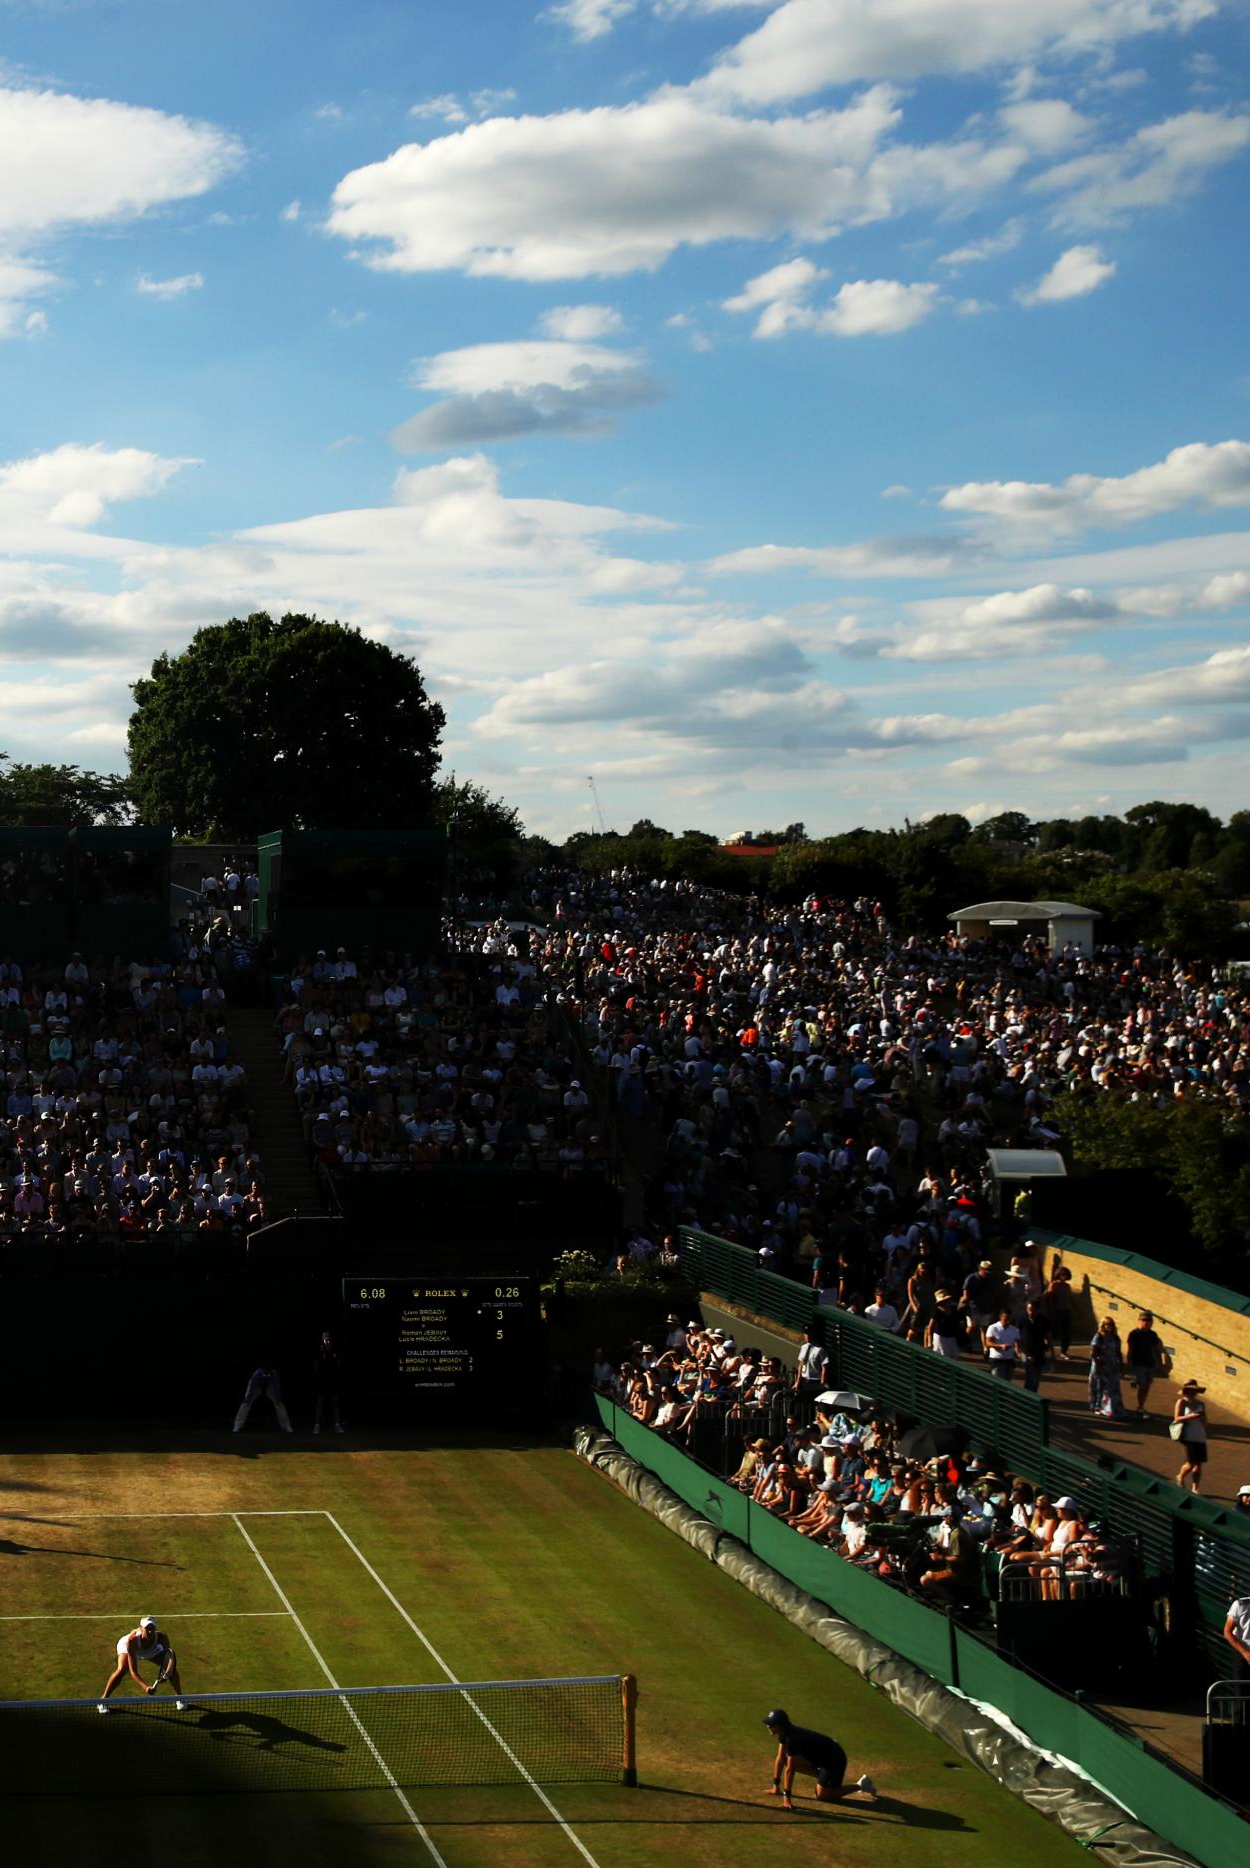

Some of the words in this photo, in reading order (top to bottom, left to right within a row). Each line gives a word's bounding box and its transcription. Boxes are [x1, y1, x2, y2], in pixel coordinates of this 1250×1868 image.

[360, 1288, 386, 1299] 6.08
[425, 1289, 457, 1297] ROLEX
[495, 1287, 520, 1298] 0.26
[496, 1310, 503, 1320] 3
[496, 1329, 504, 1340] 5
